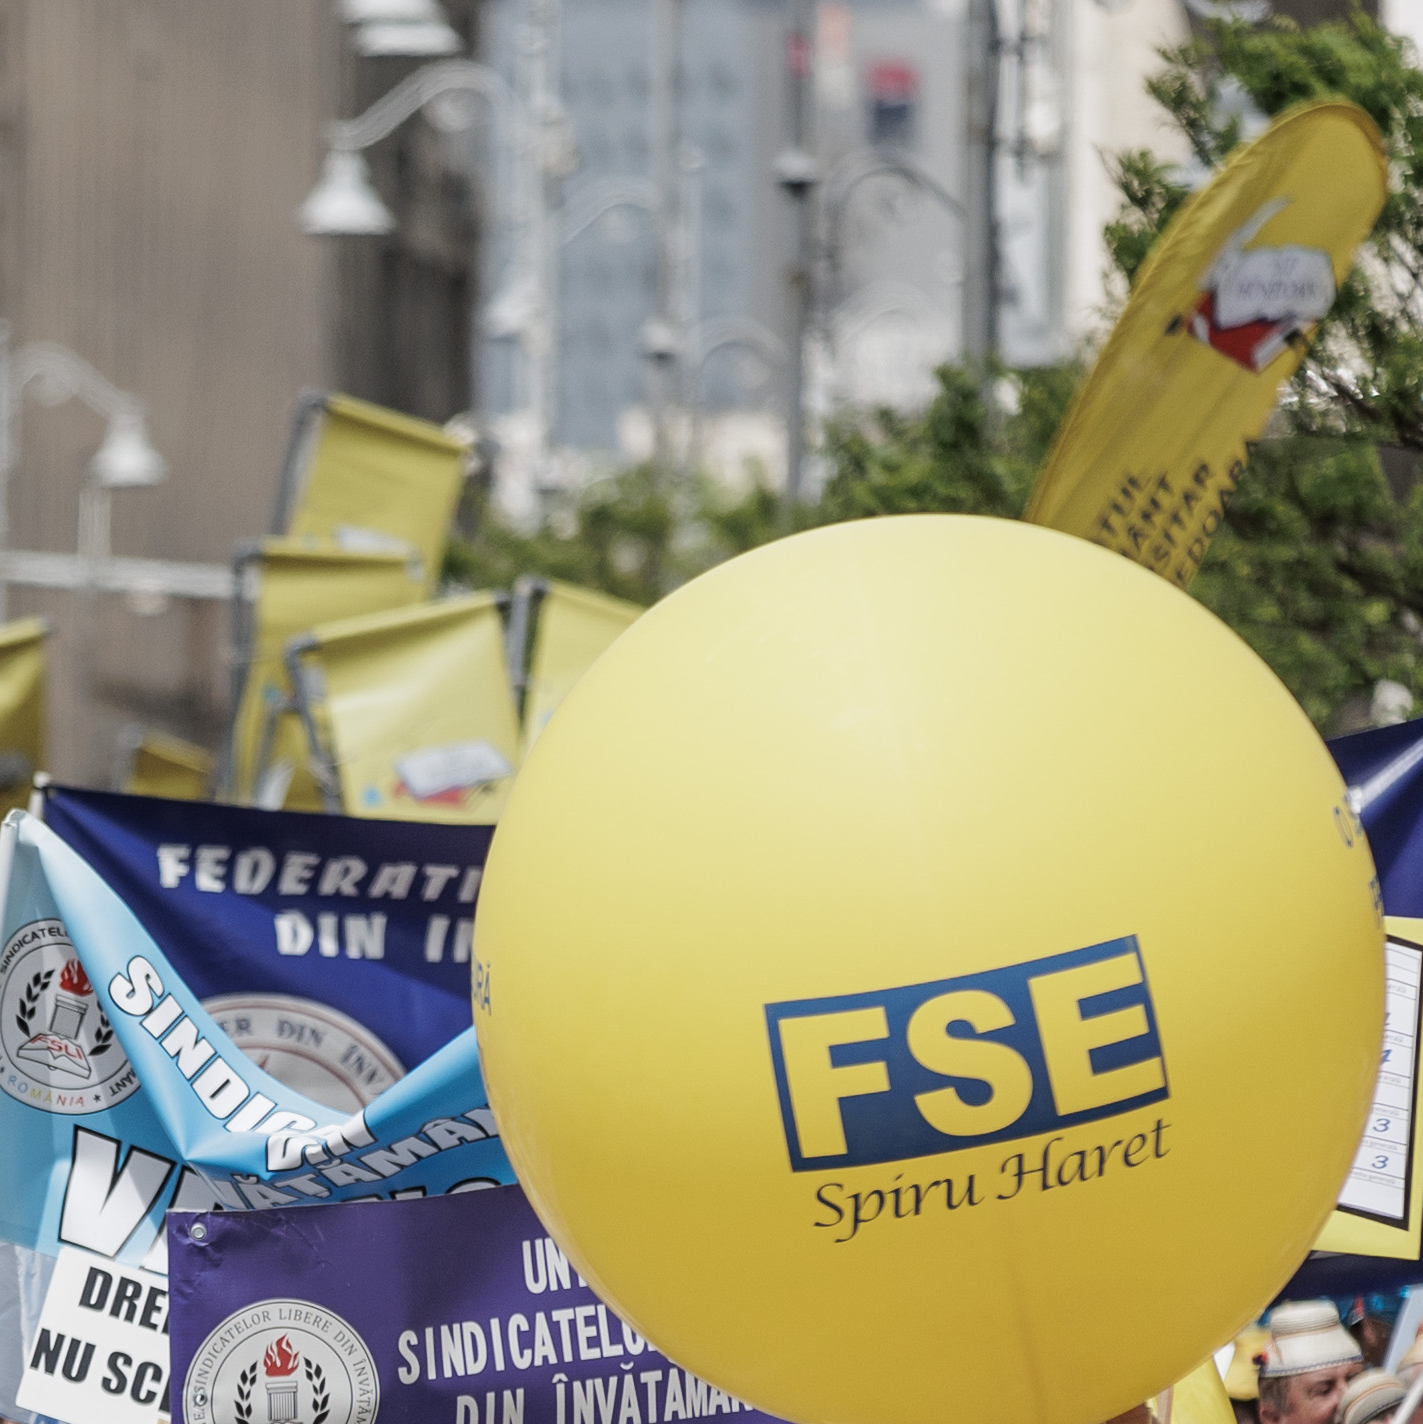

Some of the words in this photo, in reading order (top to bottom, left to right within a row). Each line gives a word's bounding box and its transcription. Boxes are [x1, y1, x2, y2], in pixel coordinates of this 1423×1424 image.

[0, 926, 68, 975] SINDICATEL
[273, 908, 389, 960] DIN
[29, 1034, 85, 1061] FSLI
[779, 951, 1167, 1159] FSE
[812, 1169, 984, 1244] Spiru
[995, 1117, 1174, 1204] Haret
[77, 1265, 168, 1337] DRE
[521, 1237, 589, 1294] UN
[28, 1326, 97, 1385] NU
[100, 1350, 170, 1414] SC
[193, 1310, 272, 1395] SINDICATELOR
[278, 1308, 333, 1334] LIBERE
[332, 1331, 359, 1357] DIN
[397, 1304, 659, 1385] SINDICATELO
